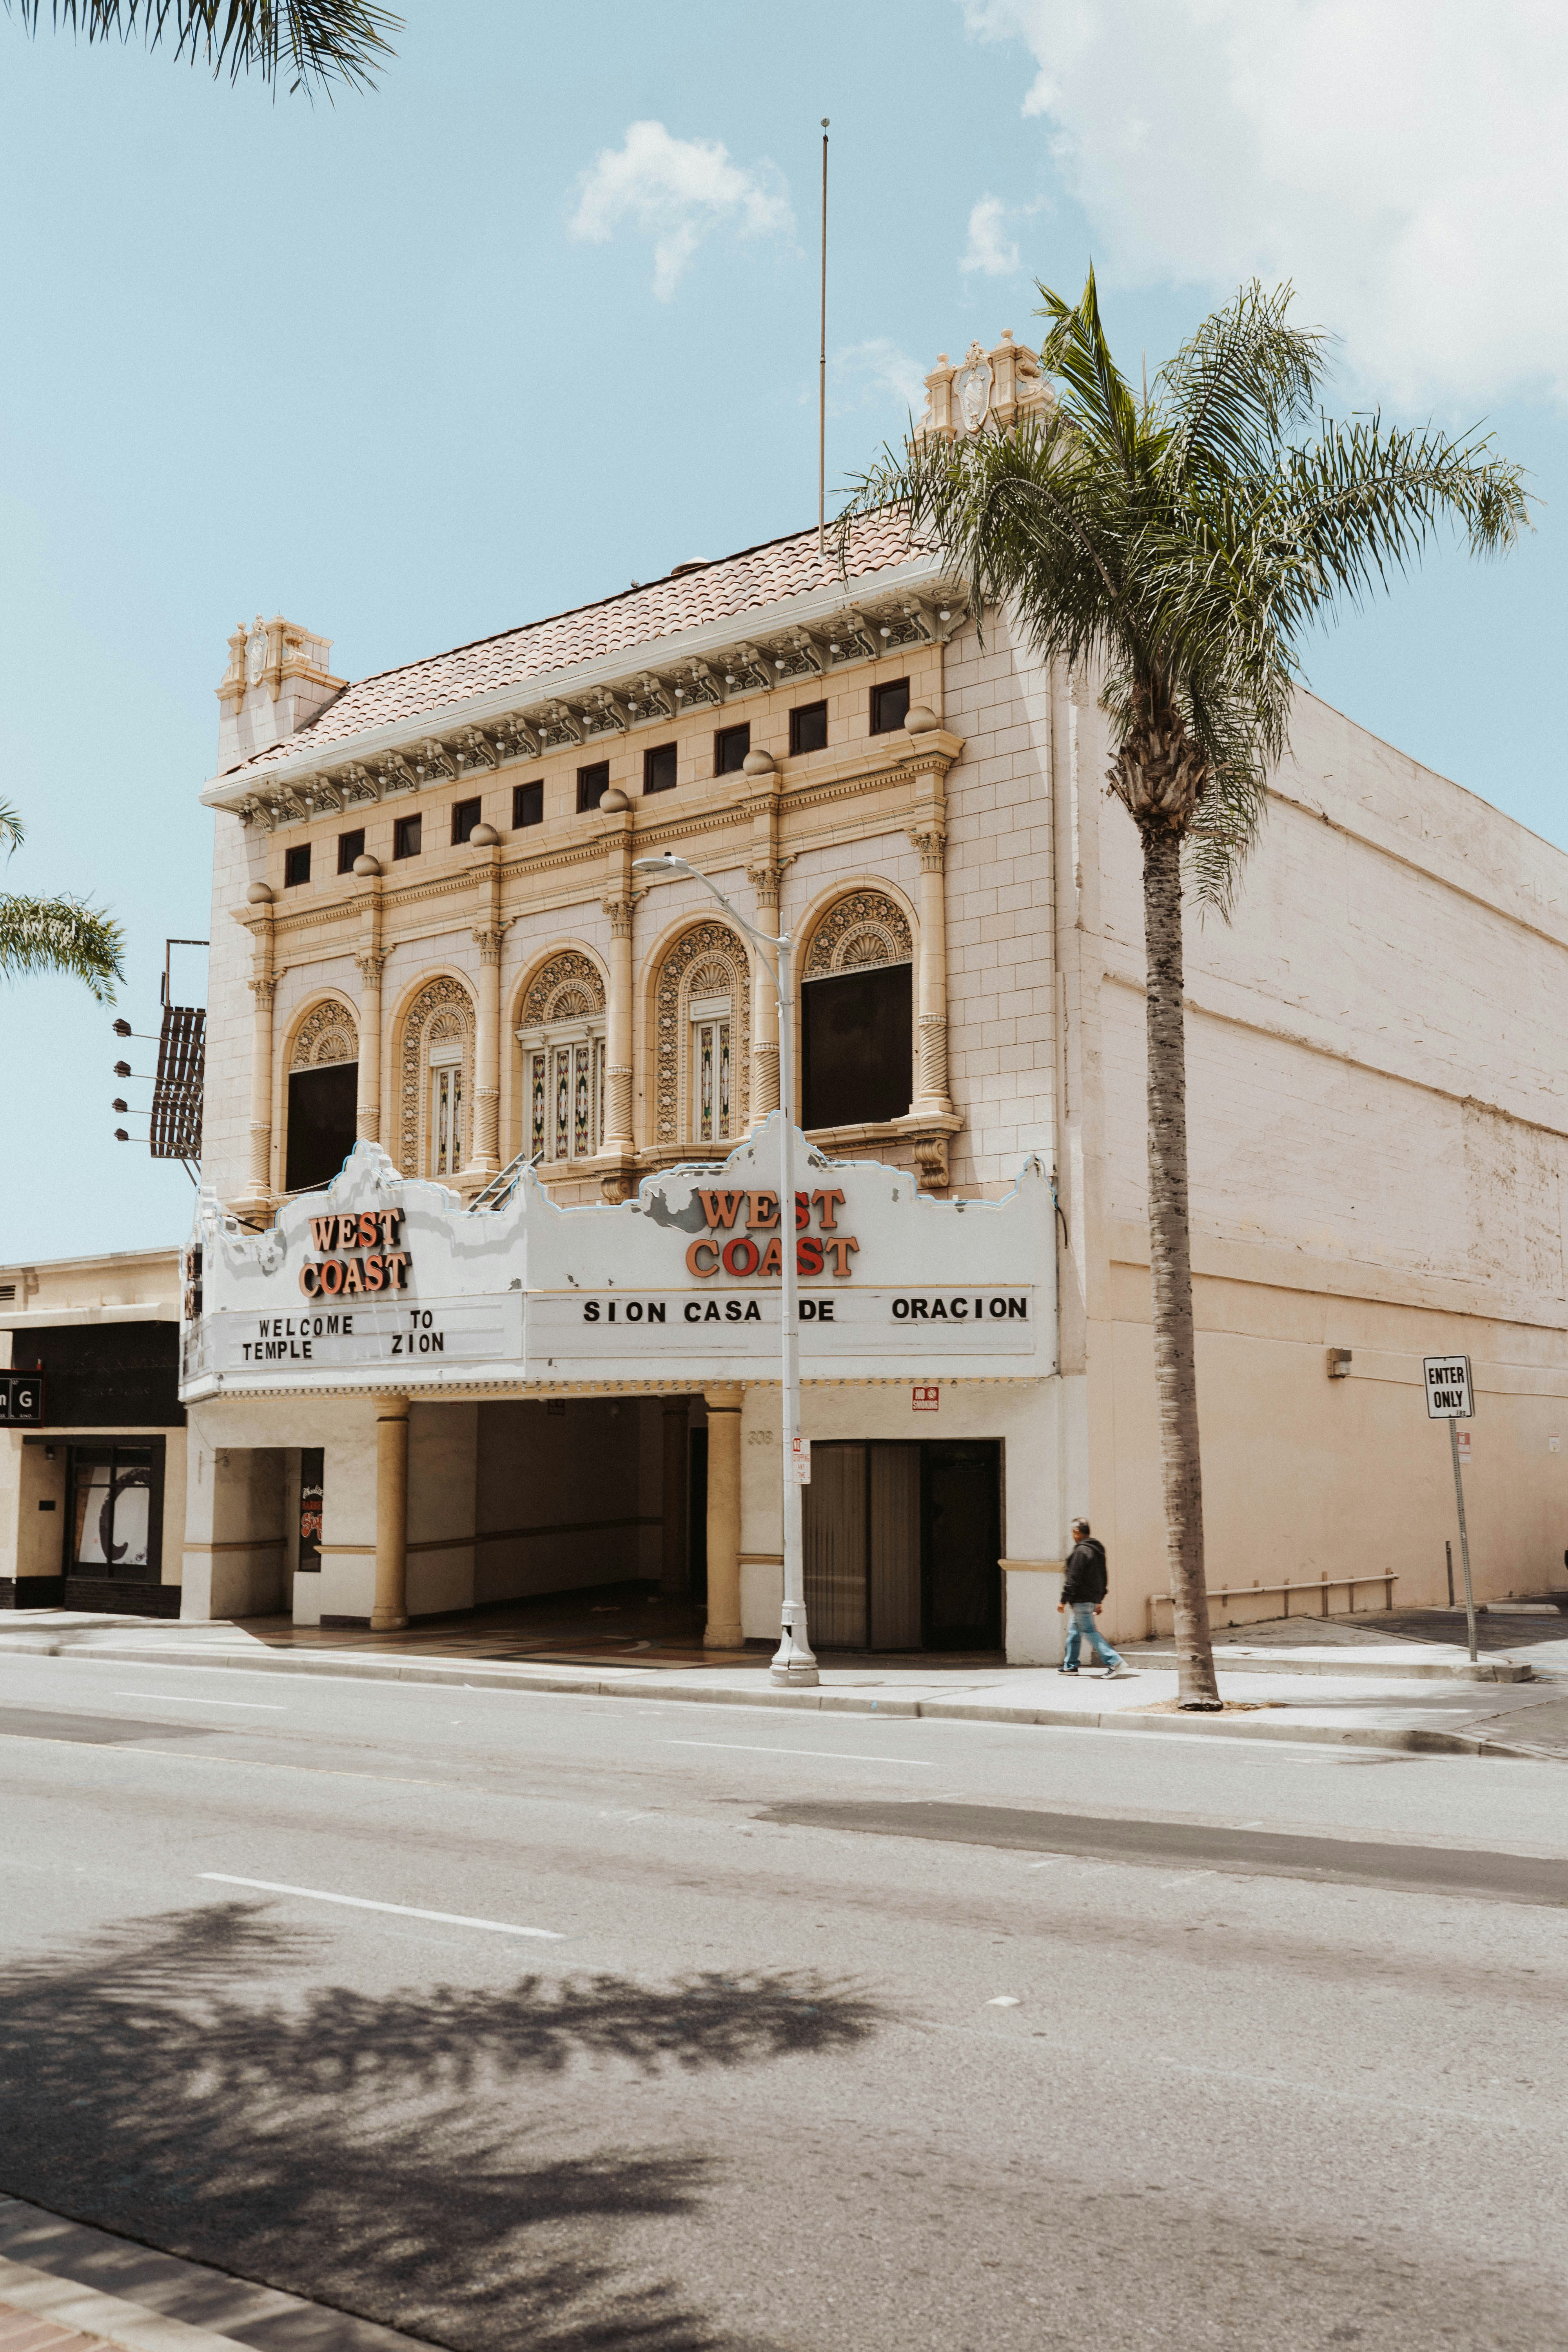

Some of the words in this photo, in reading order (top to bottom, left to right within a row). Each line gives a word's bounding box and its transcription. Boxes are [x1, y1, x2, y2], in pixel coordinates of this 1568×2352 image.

[698, 1189, 846, 1230] WEST
[308, 1207, 405, 1251] WEST
[686, 1236, 860, 1278] COAST
[299, 1252, 412, 1298] COAST
[583, 1301, 666, 1322] SION
[684, 1300, 762, 1321] CASA
[799, 1300, 834, 1321] DE
[892, 1298, 1027, 1319] ORACION
[259, 1316, 352, 1338] WELCOME
[410, 1310, 433, 1330] TO
[243, 1340, 312, 1360] TEMPLE
[392, 1332, 444, 1354] ZION
[1428, 1367, 1465, 1385] ENTER
[913, 1400, 938, 1409] SMOKING
[915, 1389, 925, 1399] NO
[1434, 1391, 1463, 1408] ONLY
[793, 1440, 800, 1450] NO
